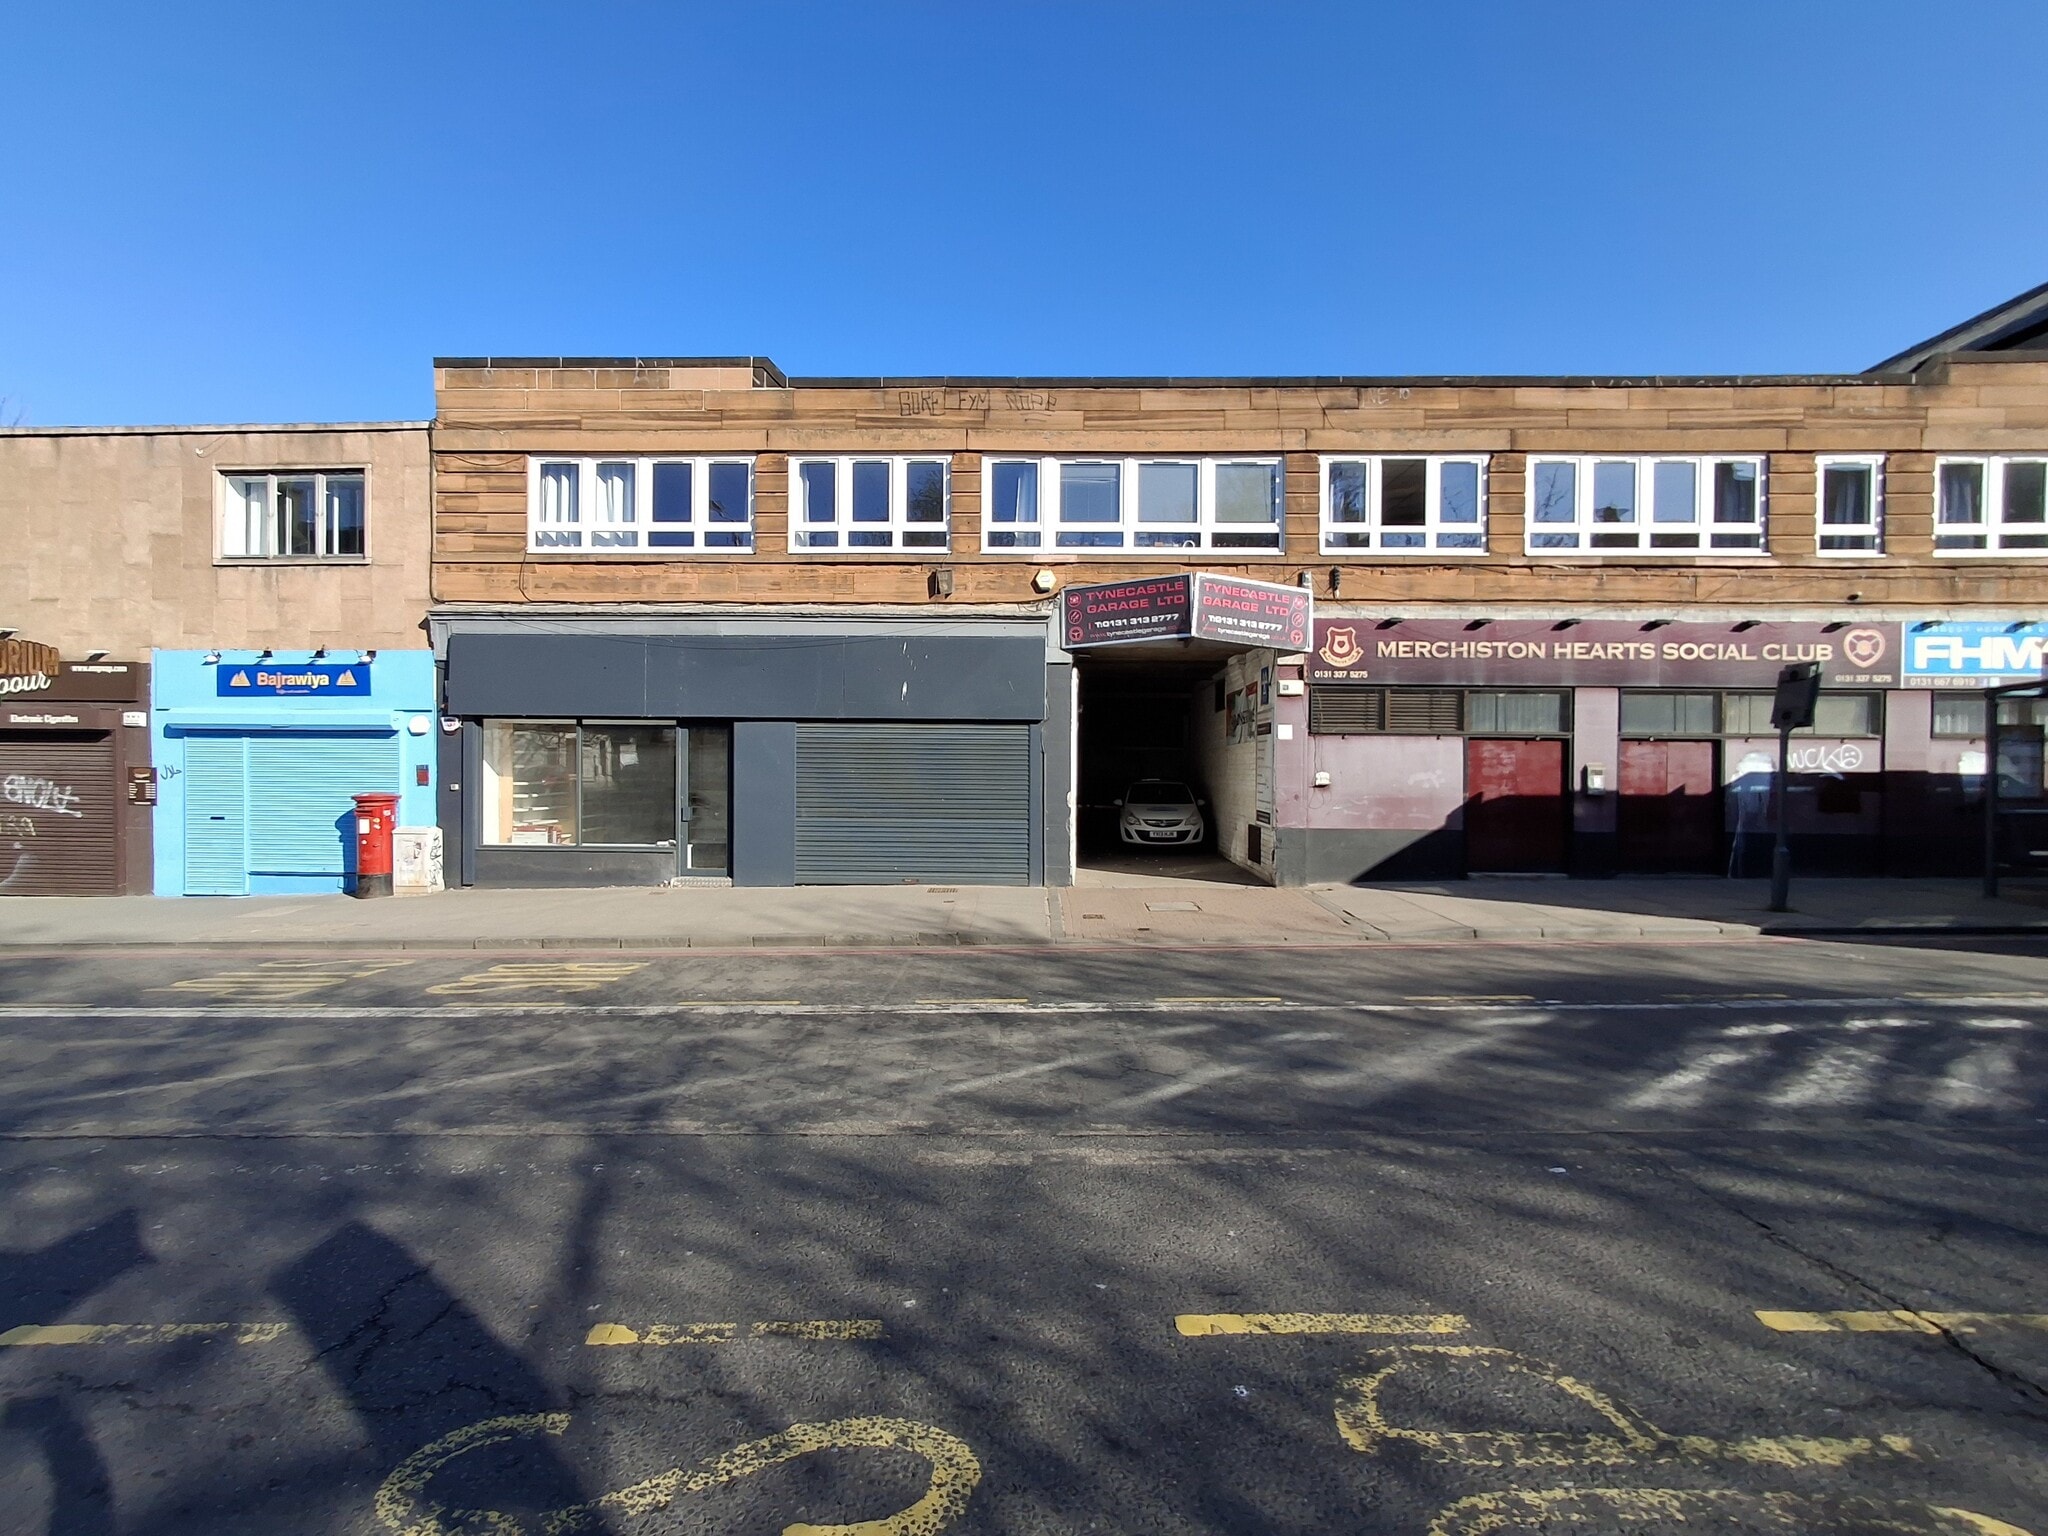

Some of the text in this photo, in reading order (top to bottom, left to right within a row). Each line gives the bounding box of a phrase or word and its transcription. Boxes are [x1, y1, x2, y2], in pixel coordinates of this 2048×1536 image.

[1086, 581, 1184, 600] TYNECASTLE
[1203, 582, 1290, 604] TYNECASTLE
[1087, 595, 1185, 613] GARAGE LTD
[1203, 596, 1289, 616] GARAGE LTD
[1130, 616, 1150, 625] 313
[1151, 614, 1179, 623] 2777
[1239, 619, 1257, 628] 313
[1258, 621, 1283, 632] 2777
[1377, 641, 1546, 659] MERCHISTON
[1554, 642, 1656, 660] HEARTS
[1662, 642, 1757, 661] SOCIAL
[1762, 643, 1833, 661] CLUB
[257, 671, 330, 689] Bajrawiya
[1314, 670, 1332, 678] 0131
[1333, 670, 1347, 678] 337
[1835, 674, 1854, 683] 0131
[1855, 674, 1870, 683] 337
[1910, 677, 1931, 686] 0131
